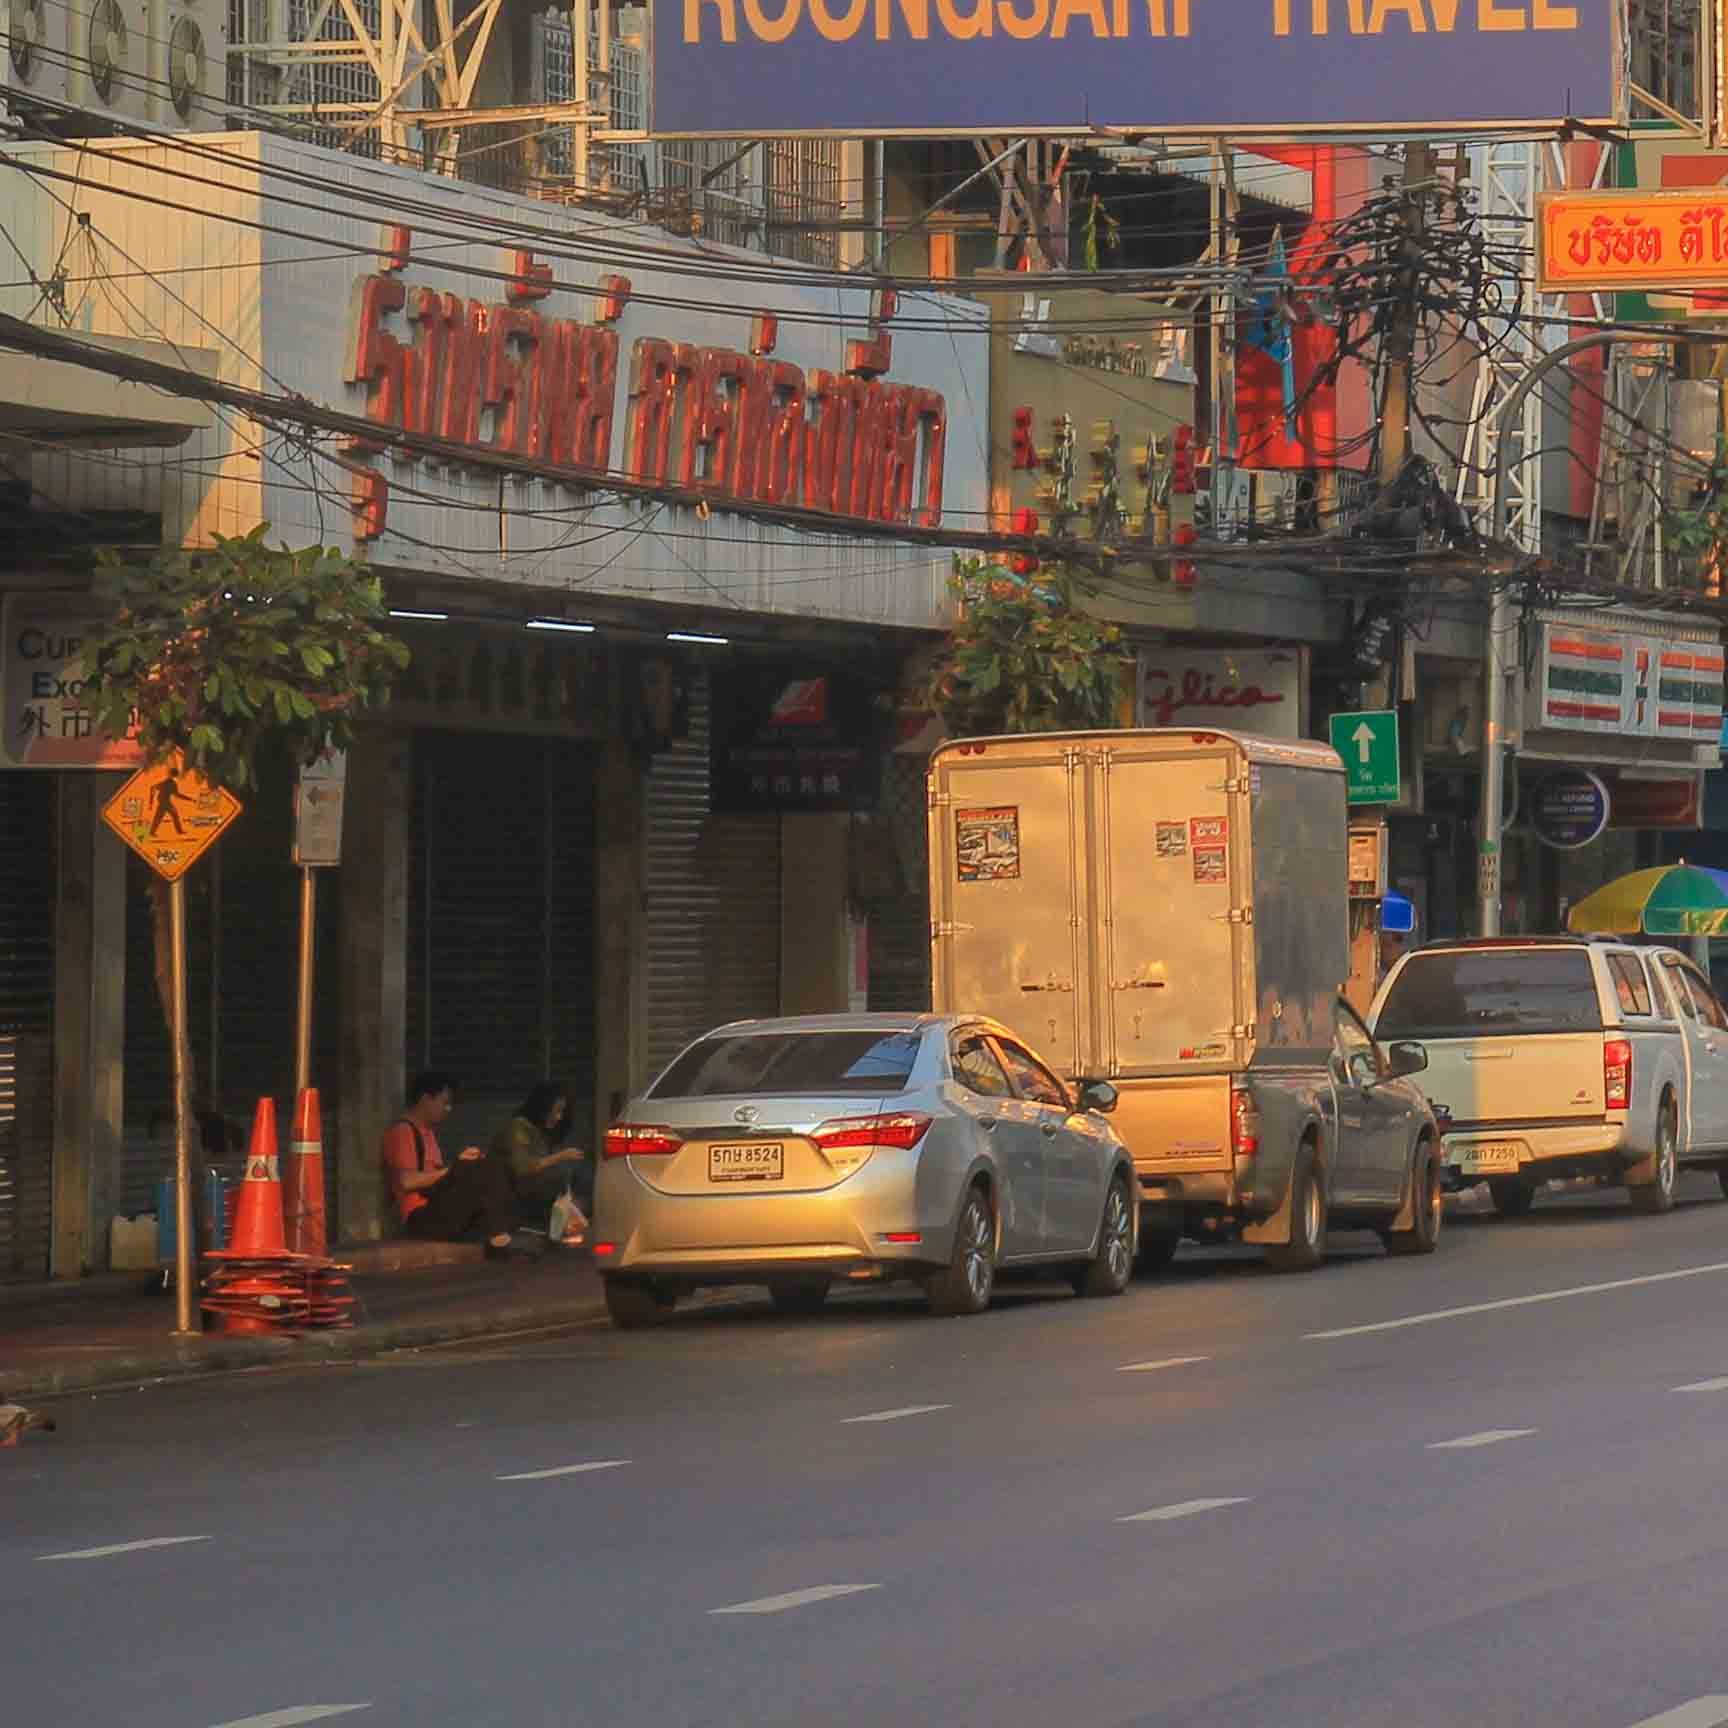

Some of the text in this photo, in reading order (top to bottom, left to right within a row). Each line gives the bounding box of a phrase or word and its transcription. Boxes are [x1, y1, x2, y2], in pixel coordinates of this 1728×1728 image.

[1567, 213, 1661, 266] บริษัท
[745, 1147, 779, 1162] 8524
